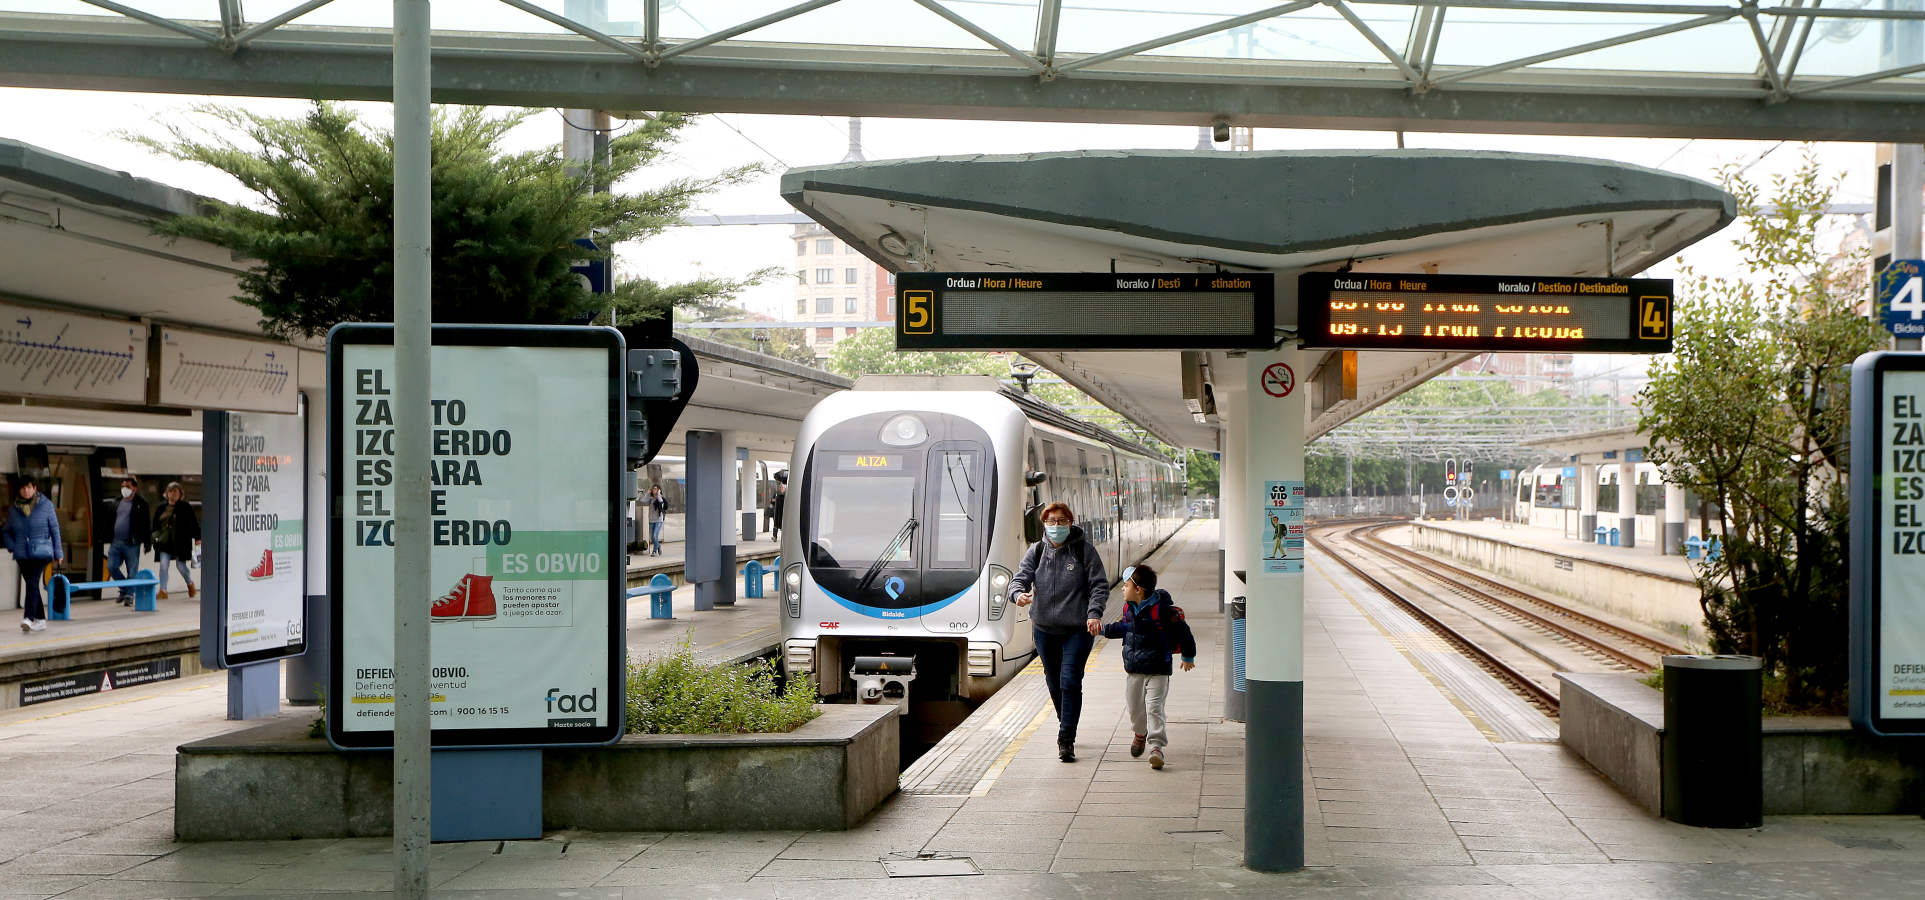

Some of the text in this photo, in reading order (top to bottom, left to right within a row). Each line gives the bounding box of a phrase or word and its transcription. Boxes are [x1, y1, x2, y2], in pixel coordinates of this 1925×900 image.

[946, 278, 976, 288] Ordua
[983, 278, 1006, 288] Hora
[1014, 278, 1042, 289] Heure
[1116, 279, 1149, 289] Norako
[1158, 278, 1181, 288] Desti
[1211, 278, 1251, 288] stination
[1334, 279, 1362, 290] Ordua
[1370, 280, 1392, 290] Hora
[1400, 280, 1427, 291] Heure
[1498, 282, 1530, 293] Norako
[1538, 282, 1572, 293] Destino
[1579, 283, 1628, 294] Destination
[1890, 276, 1925, 320] 4
[908, 296, 928, 328] 5
[1643, 302, 1664, 334] 4
[356, 369, 390, 395] EL
[355, 400, 466, 426] ZATO
[1893, 395, 1922, 418] EL
[232, 416, 244, 432] EL
[232, 436, 264, 453] ZAPATO
[356, 430, 512, 456] IZQERDO
[232, 456, 278, 474] IZQUIERDO
[856, 456, 888, 467] ALTZA
[356, 460, 392, 486] ES
[232, 475, 270, 492] ES PARA
[1894, 476, 1924, 500] ES
[232, 495, 260, 512] EL PIE
[356, 490, 390, 516] EL
[232, 514, 278, 533] IZQUIERDO
[1894, 504, 1922, 527] EL
[356, 520, 512, 546] IZQERDO
[502, 552, 600, 574] ES OBVIO
[288, 618, 301, 636] fad
[356, 667, 470, 679] DEFIEN OBVIO.
[380, 692, 391, 700] de
[545, 688, 596, 713] fad
